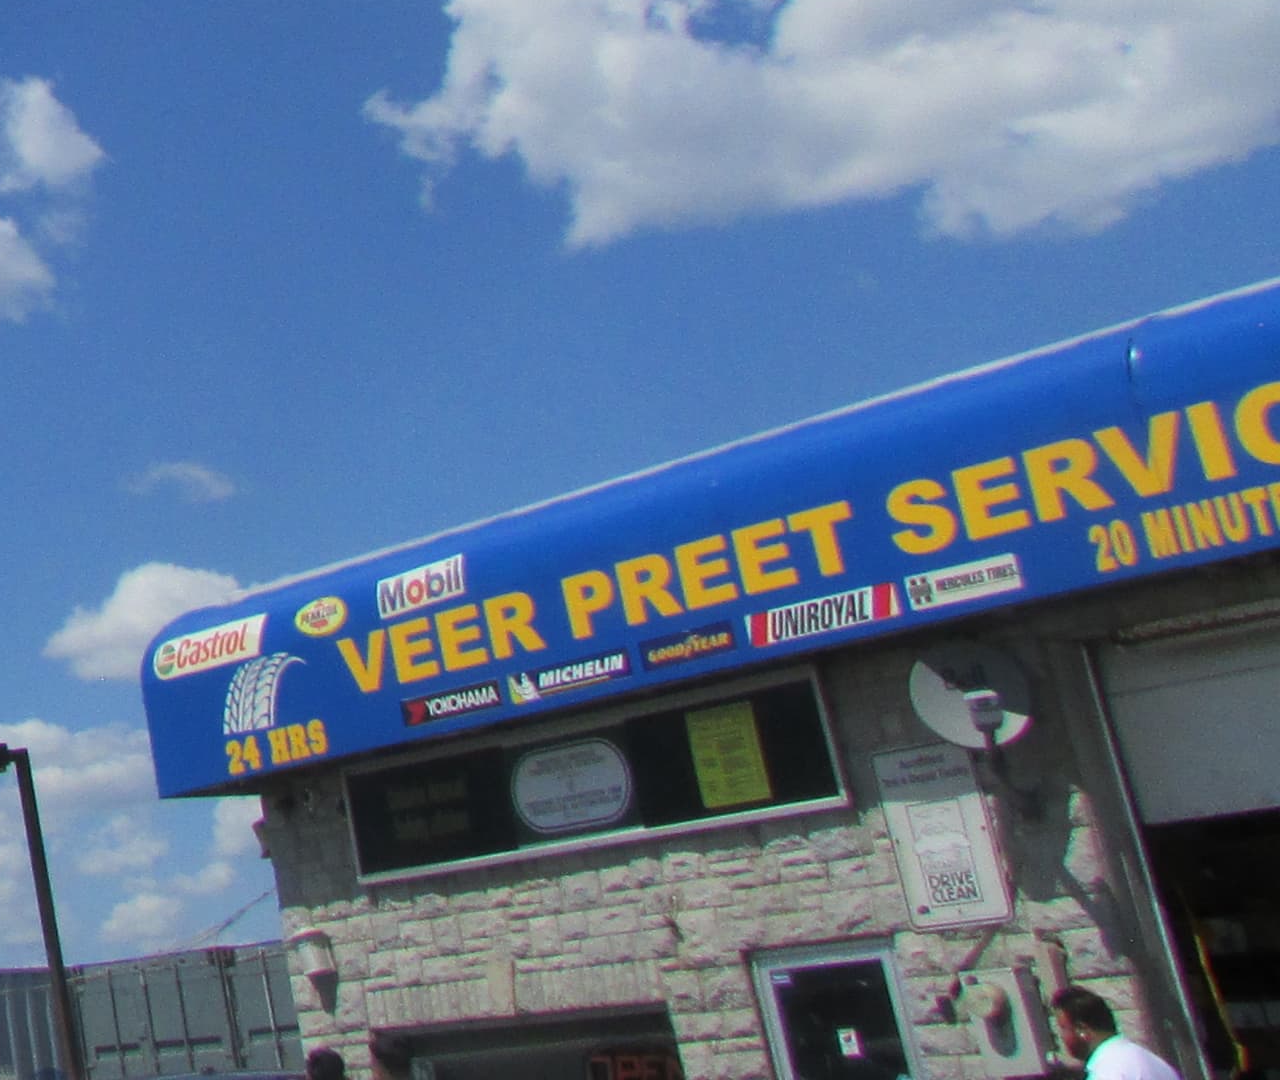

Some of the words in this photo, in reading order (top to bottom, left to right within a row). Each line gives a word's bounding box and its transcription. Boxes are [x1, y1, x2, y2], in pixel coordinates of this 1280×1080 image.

[1087, 519, 1139, 573] 20
[336, 591, 547, 695] VEER
[561, 499, 853, 640] PREET
[379, 555, 463, 616] Mobil
[770, 590, 870, 641] UNIROYAL
[175, 622, 248, 669] Castrol
[539, 653, 624, 689] MICHELIN
[425, 684, 500, 717] YOKOHAMA
[225, 734, 263, 776] 24
[267, 718, 330, 765] HRS
[927, 870, 975, 890] DRIVE
[931, 884, 978, 904] CLEAN
